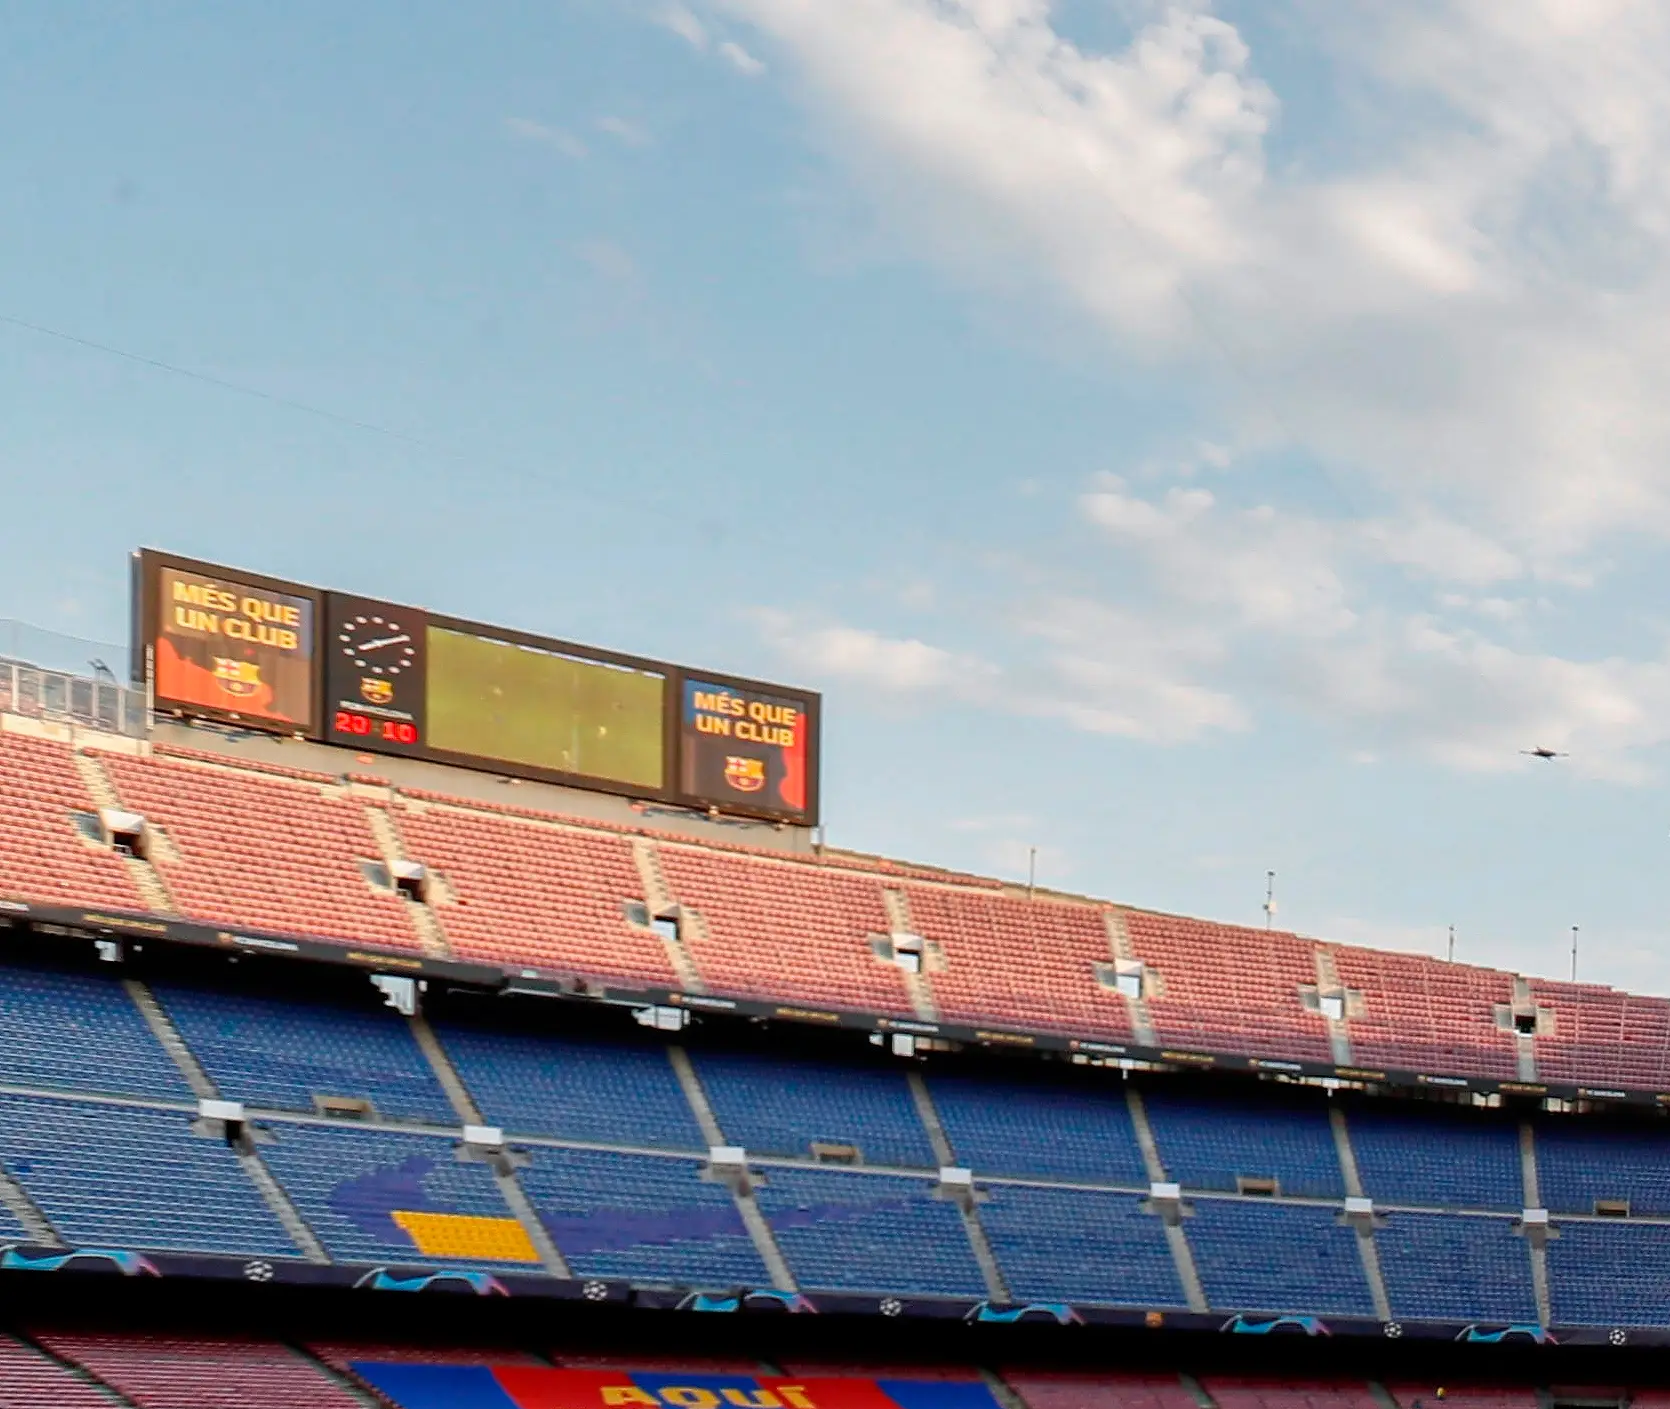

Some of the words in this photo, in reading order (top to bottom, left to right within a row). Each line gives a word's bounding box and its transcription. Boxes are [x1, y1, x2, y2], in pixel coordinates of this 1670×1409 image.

[173, 581, 236, 612] MÉS
[241, 597, 300, 627] QUE
[175, 606, 218, 633] UN
[223, 617, 298, 649] CLUB
[694, 691, 745, 717] MÉS
[749, 701, 797, 726] QUE
[696, 713, 731, 736] UN
[735, 720, 795, 747] CLUB
